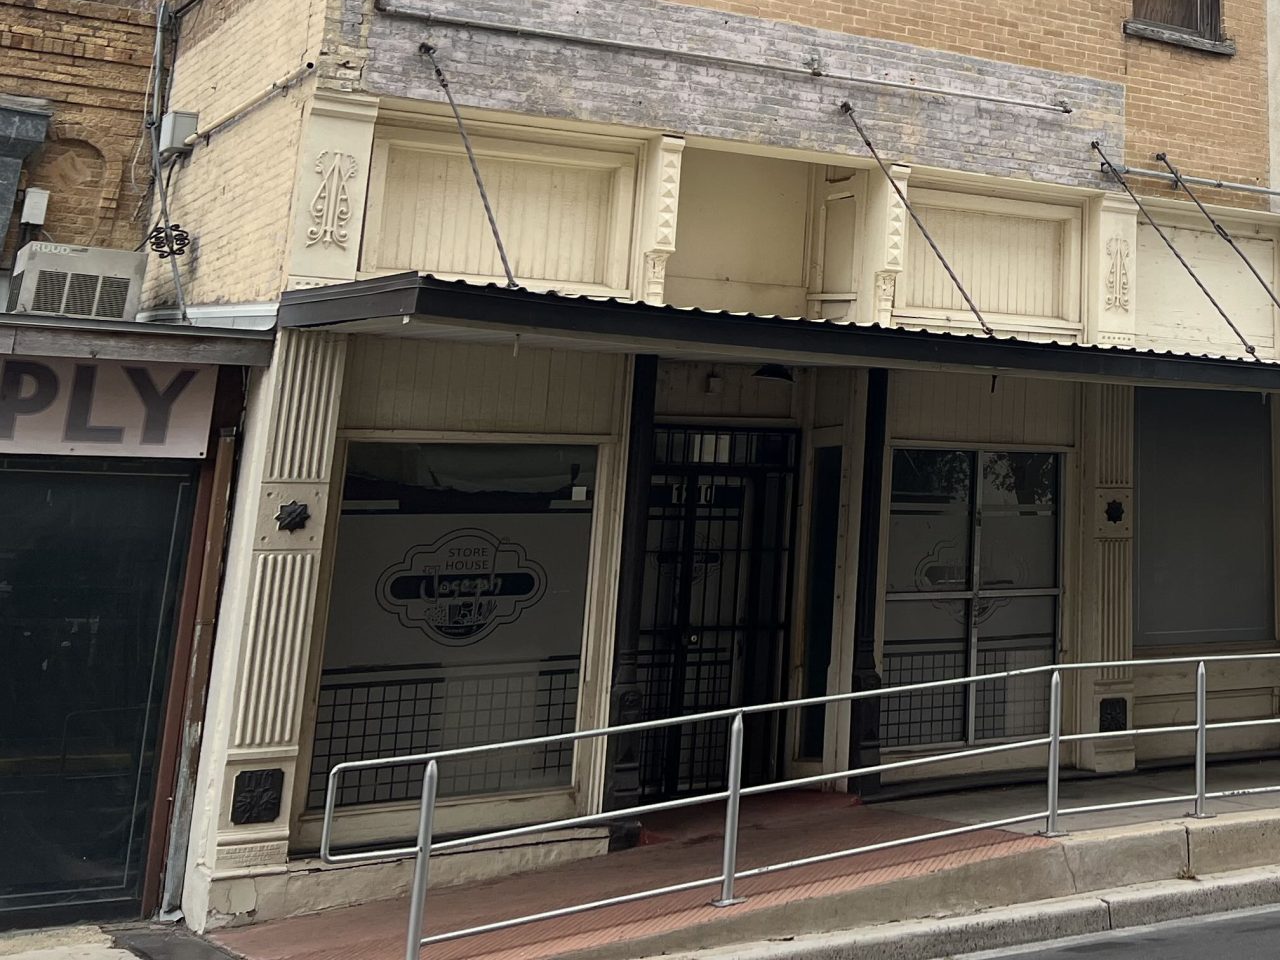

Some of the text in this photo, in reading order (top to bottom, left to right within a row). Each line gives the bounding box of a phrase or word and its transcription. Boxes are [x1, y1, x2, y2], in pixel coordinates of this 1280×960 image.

[32, 243, 70, 255] RUUD
[0, 358, 201, 445] PLY
[448, 547, 489, 558] STORE
[445, 560, 489, 571] HOUSE
